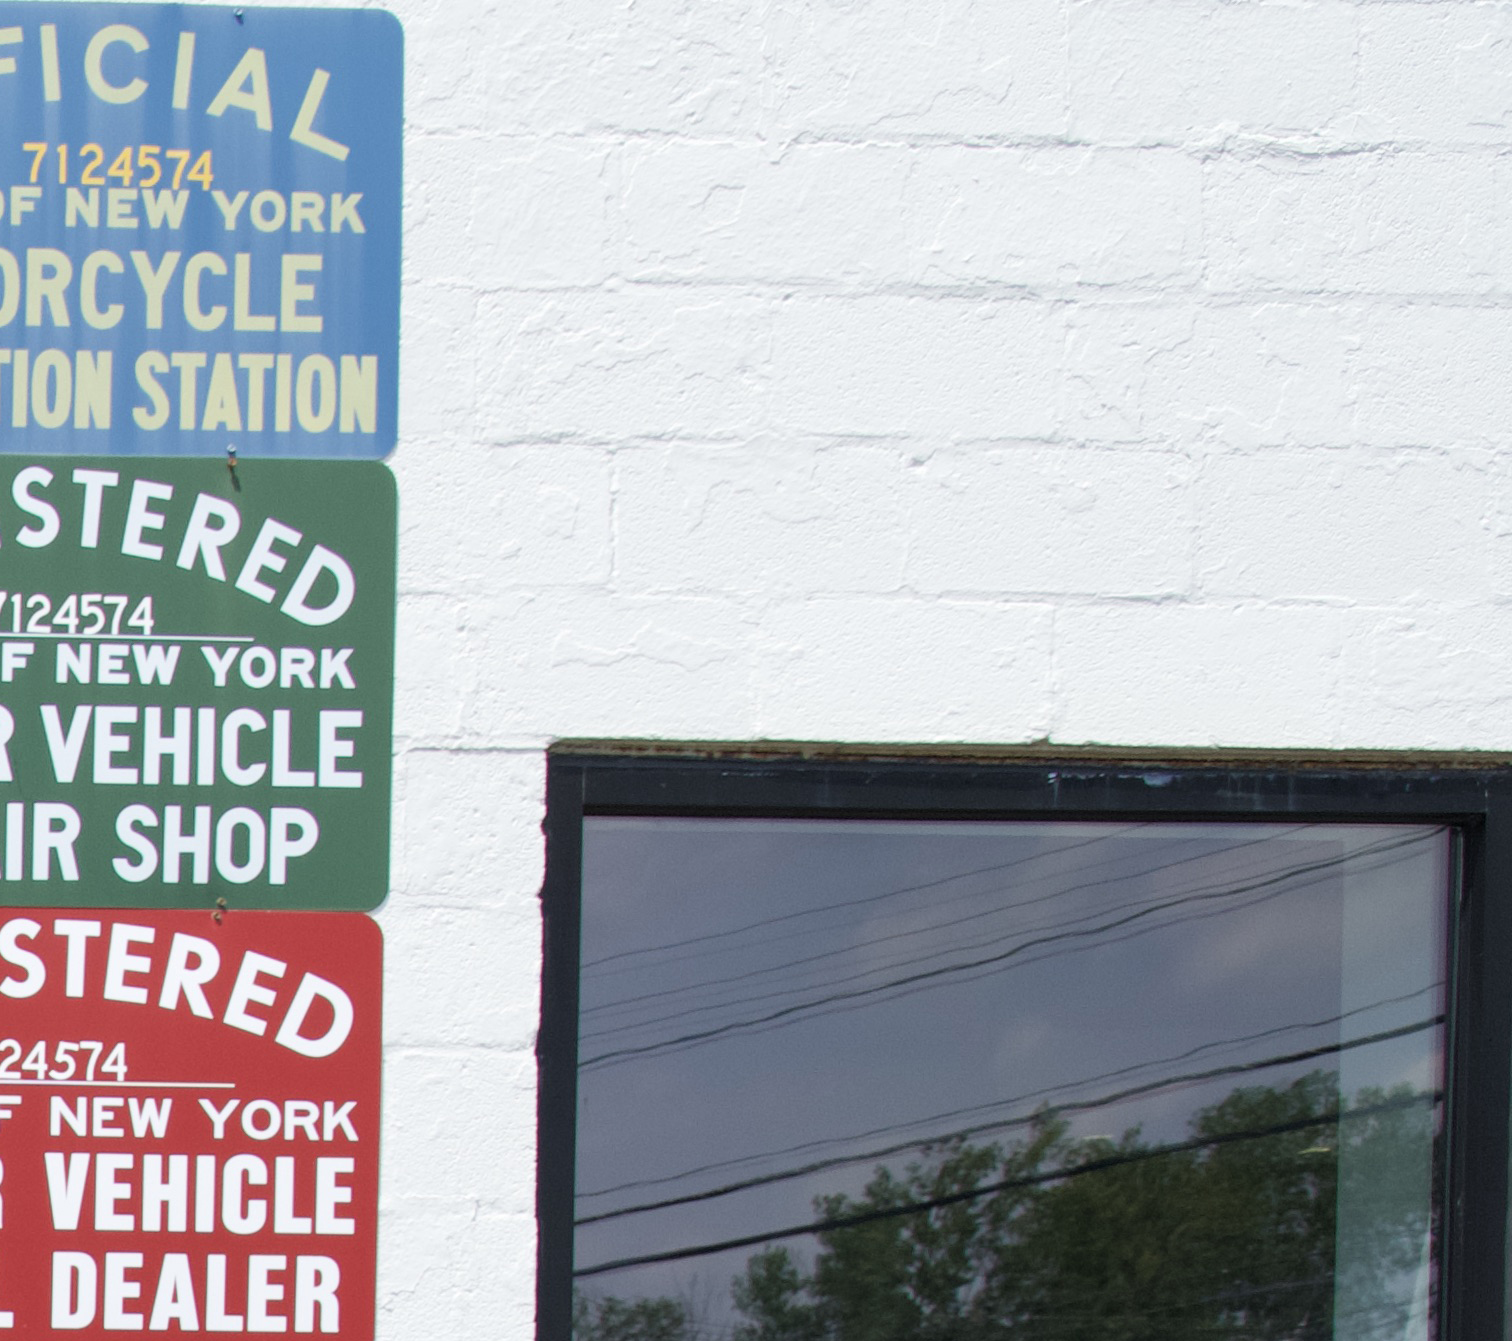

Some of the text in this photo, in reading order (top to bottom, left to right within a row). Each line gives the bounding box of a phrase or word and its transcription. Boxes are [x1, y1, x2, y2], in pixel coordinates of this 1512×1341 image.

[23, 142, 214, 190] 7124574
[65, 189, 189, 230] NEW
[213, 191, 366, 234] YORK
[133, 351, 377, 433] STATION
[56, 644, 180, 685] NEW
[201, 646, 355, 689] YORK
[40, 705, 363, 788] VEHICLE
[112, 805, 319, 885] SHOP
[50, 1097, 172, 1138] NEW
[198, 1099, 359, 1141] YORK
[45, 1152, 355, 1235] VEHICLE
[51, 1251, 341, 1333] DEALER
